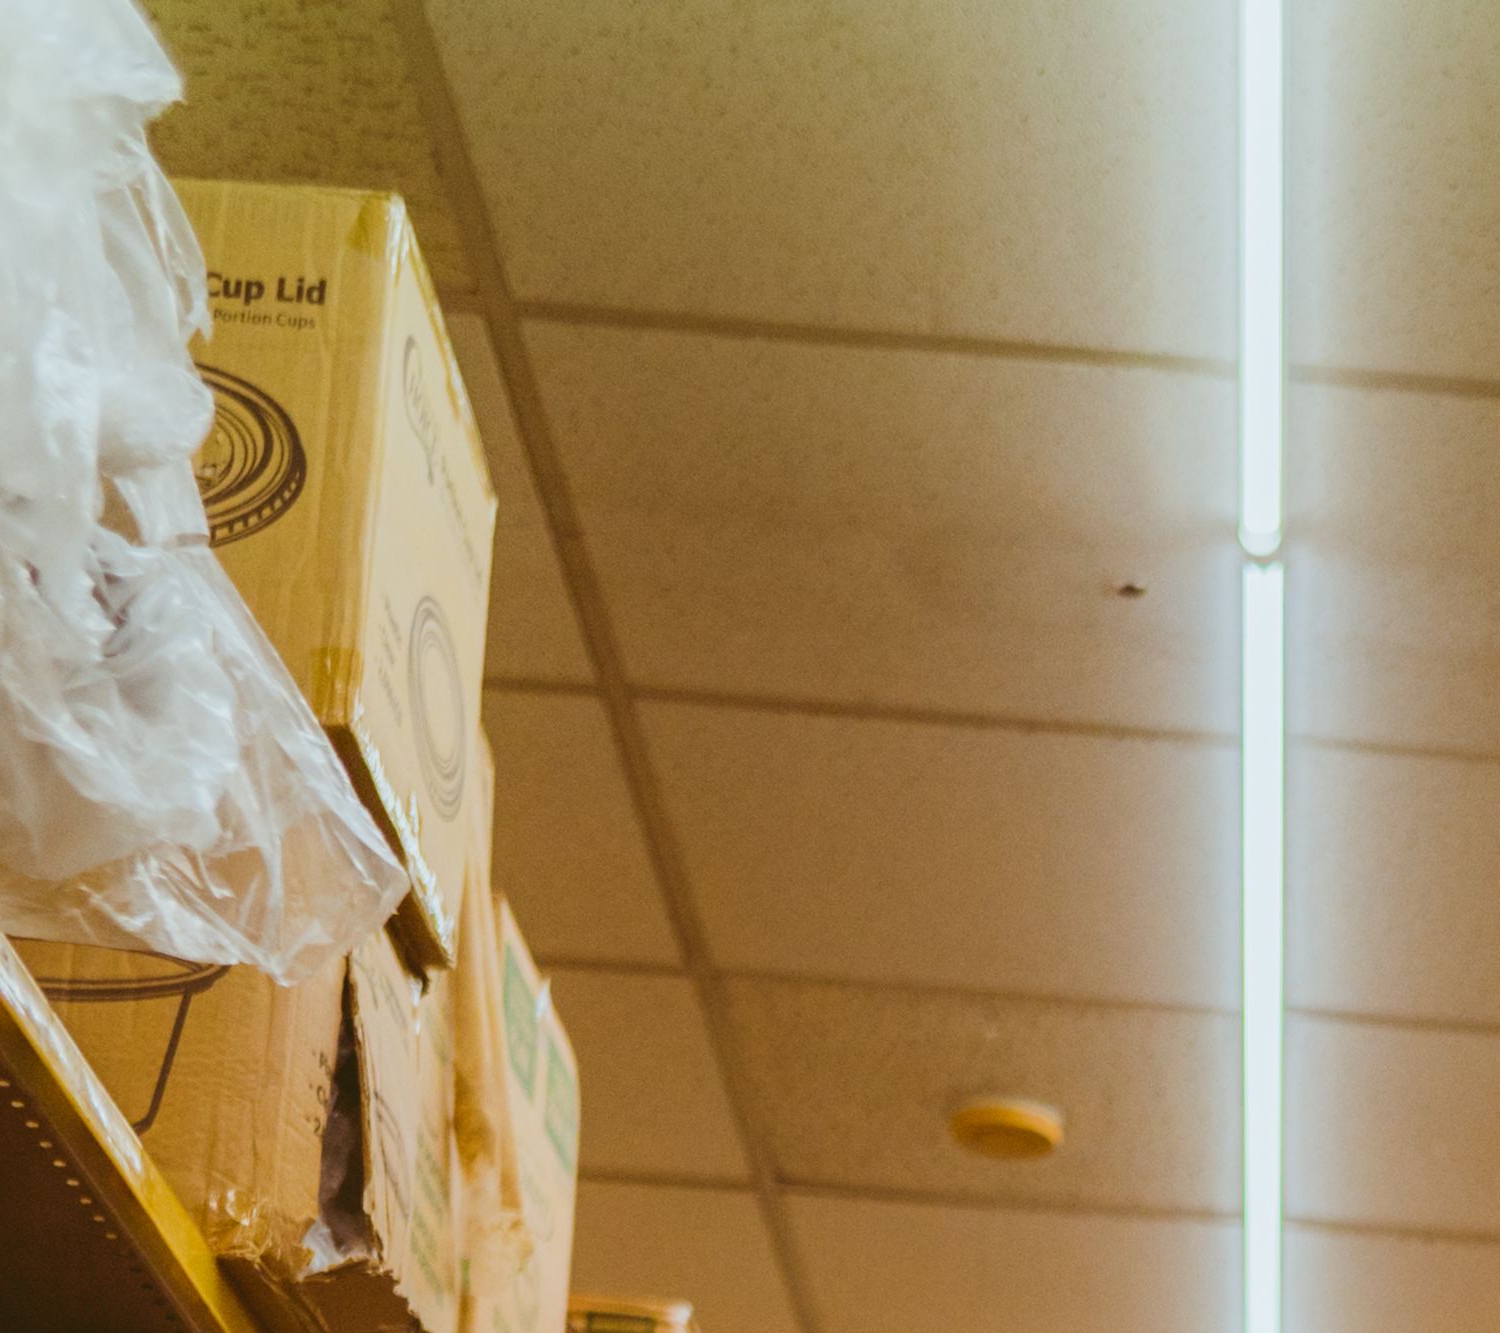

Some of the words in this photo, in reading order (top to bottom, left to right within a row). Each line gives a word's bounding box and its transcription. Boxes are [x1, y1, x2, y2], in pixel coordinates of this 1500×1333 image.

[207, 271, 265, 306] Cup
[276, 274, 328, 305] Lid
[213, 308, 272, 326] Portion
[275, 312, 317, 331] Cups
